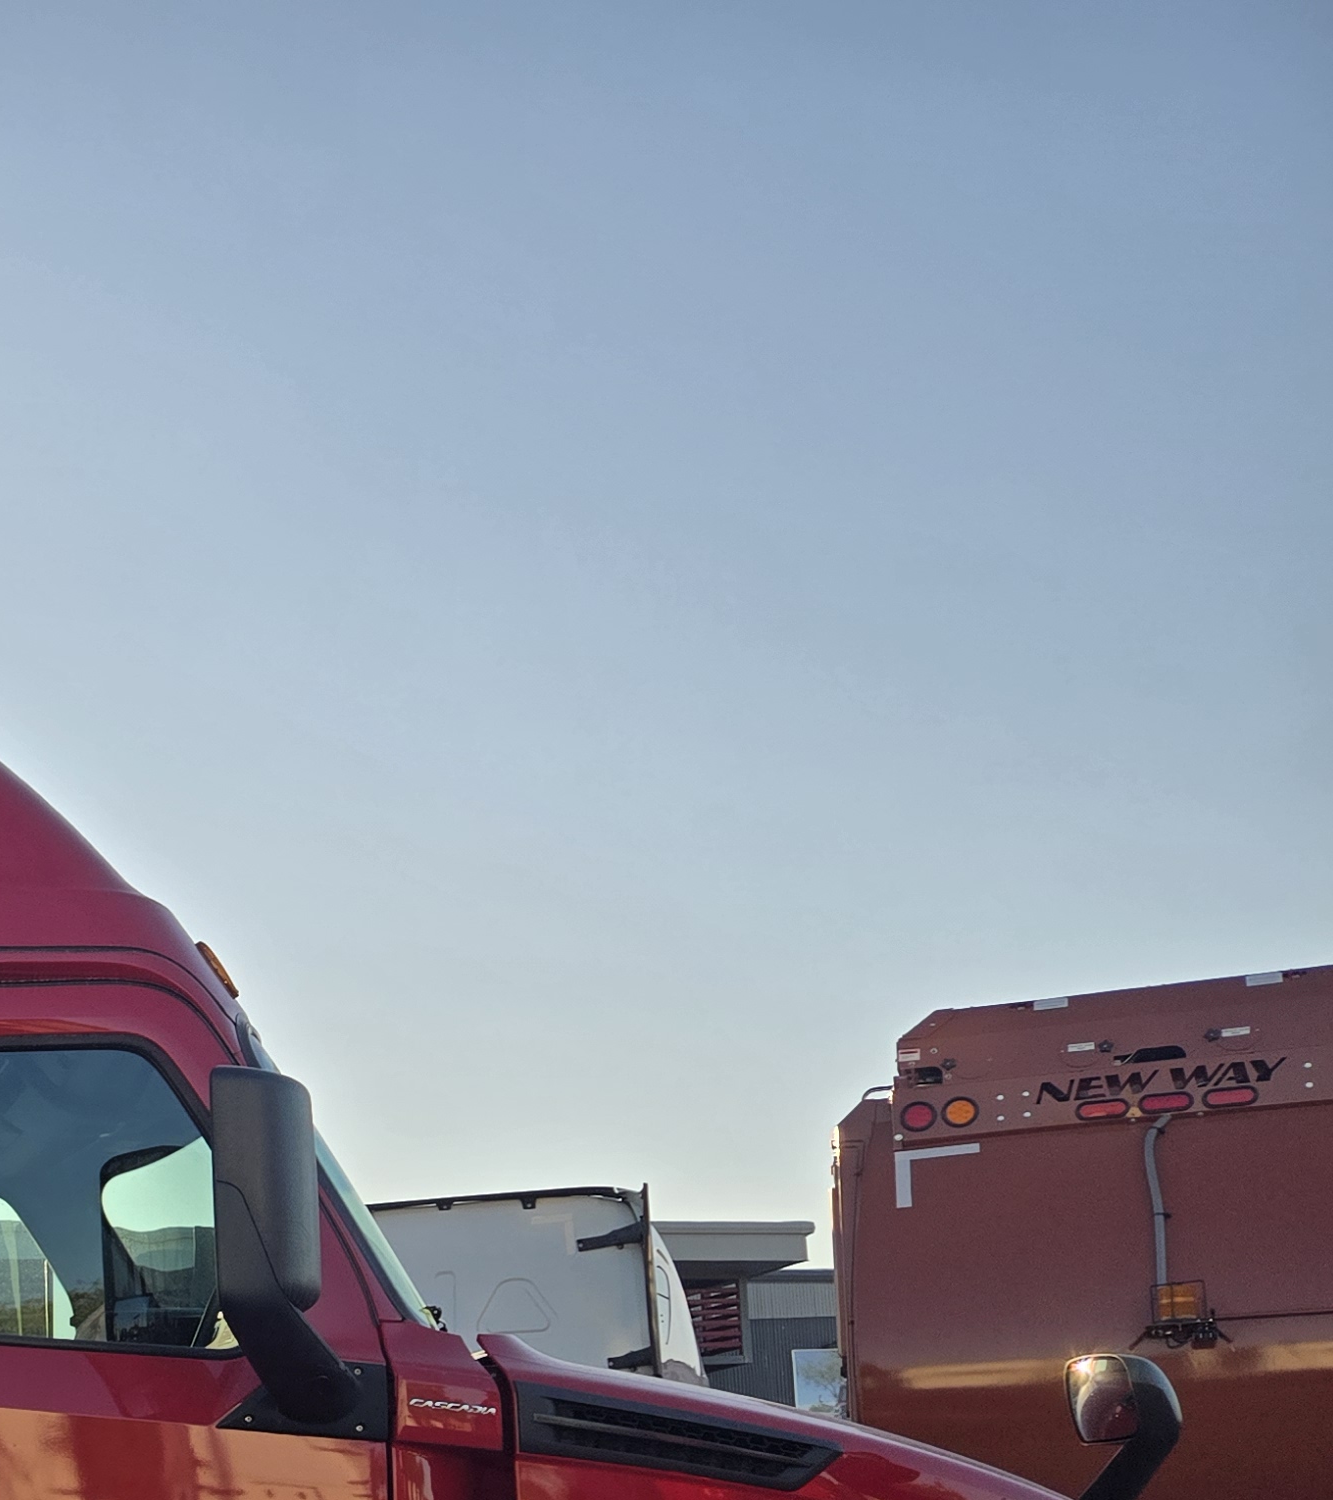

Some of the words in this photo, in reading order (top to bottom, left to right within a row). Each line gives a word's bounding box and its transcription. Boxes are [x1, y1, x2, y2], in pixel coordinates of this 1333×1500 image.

[1035, 1069, 1160, 1105] NEW
[1169, 1056, 1287, 1090] WAY
[409, 1398, 497, 1415] CASCADIA
